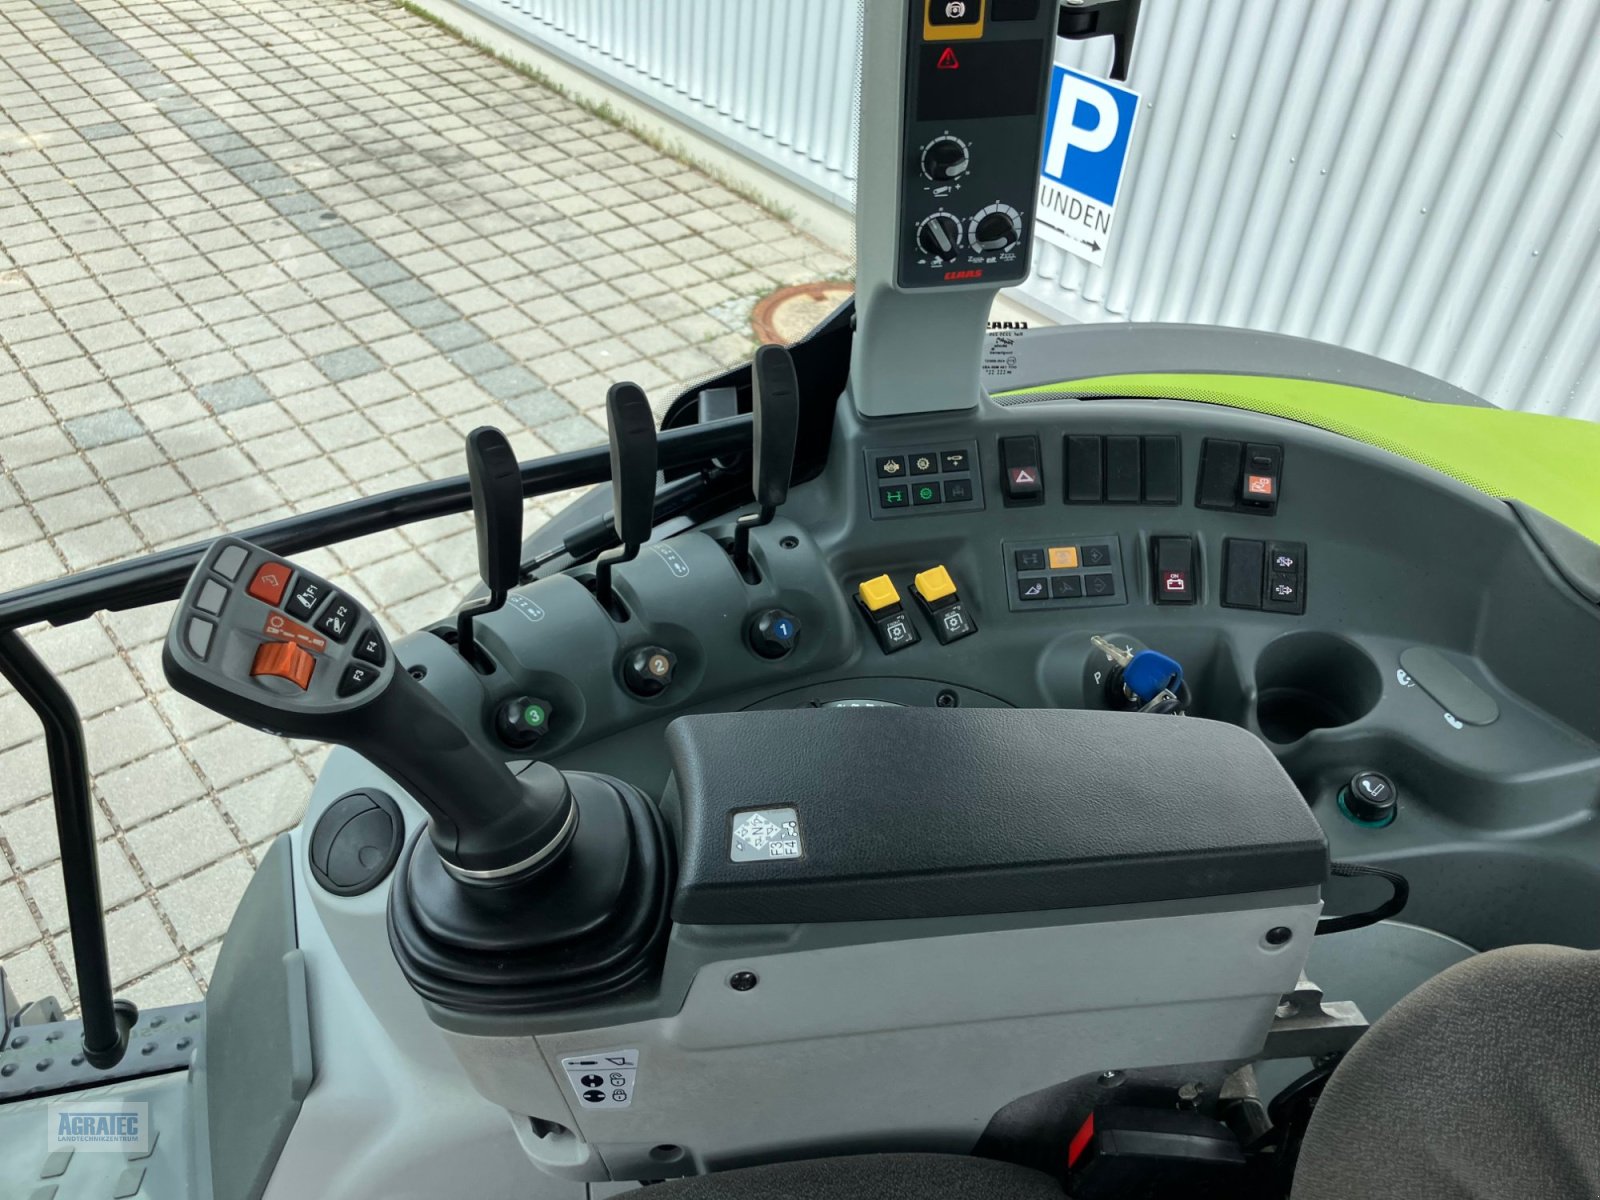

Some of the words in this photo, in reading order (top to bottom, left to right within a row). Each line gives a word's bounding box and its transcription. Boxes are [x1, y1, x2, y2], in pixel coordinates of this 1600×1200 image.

[1045, 73, 1119, 179] P
[943, 268, 984, 280] CLAAS
[307, 584, 318, 597] F1
[337, 606, 348, 617] F2
[780, 623, 788, 635] 1
[366, 640, 378, 652] F4
[654, 659, 665, 673] 2
[353, 669, 364, 681] F3
[1093, 671, 1101, 685] P
[529, 709, 540, 722] 3
[770, 841, 782, 856] F3
[785, 840, 797, 855] F4
